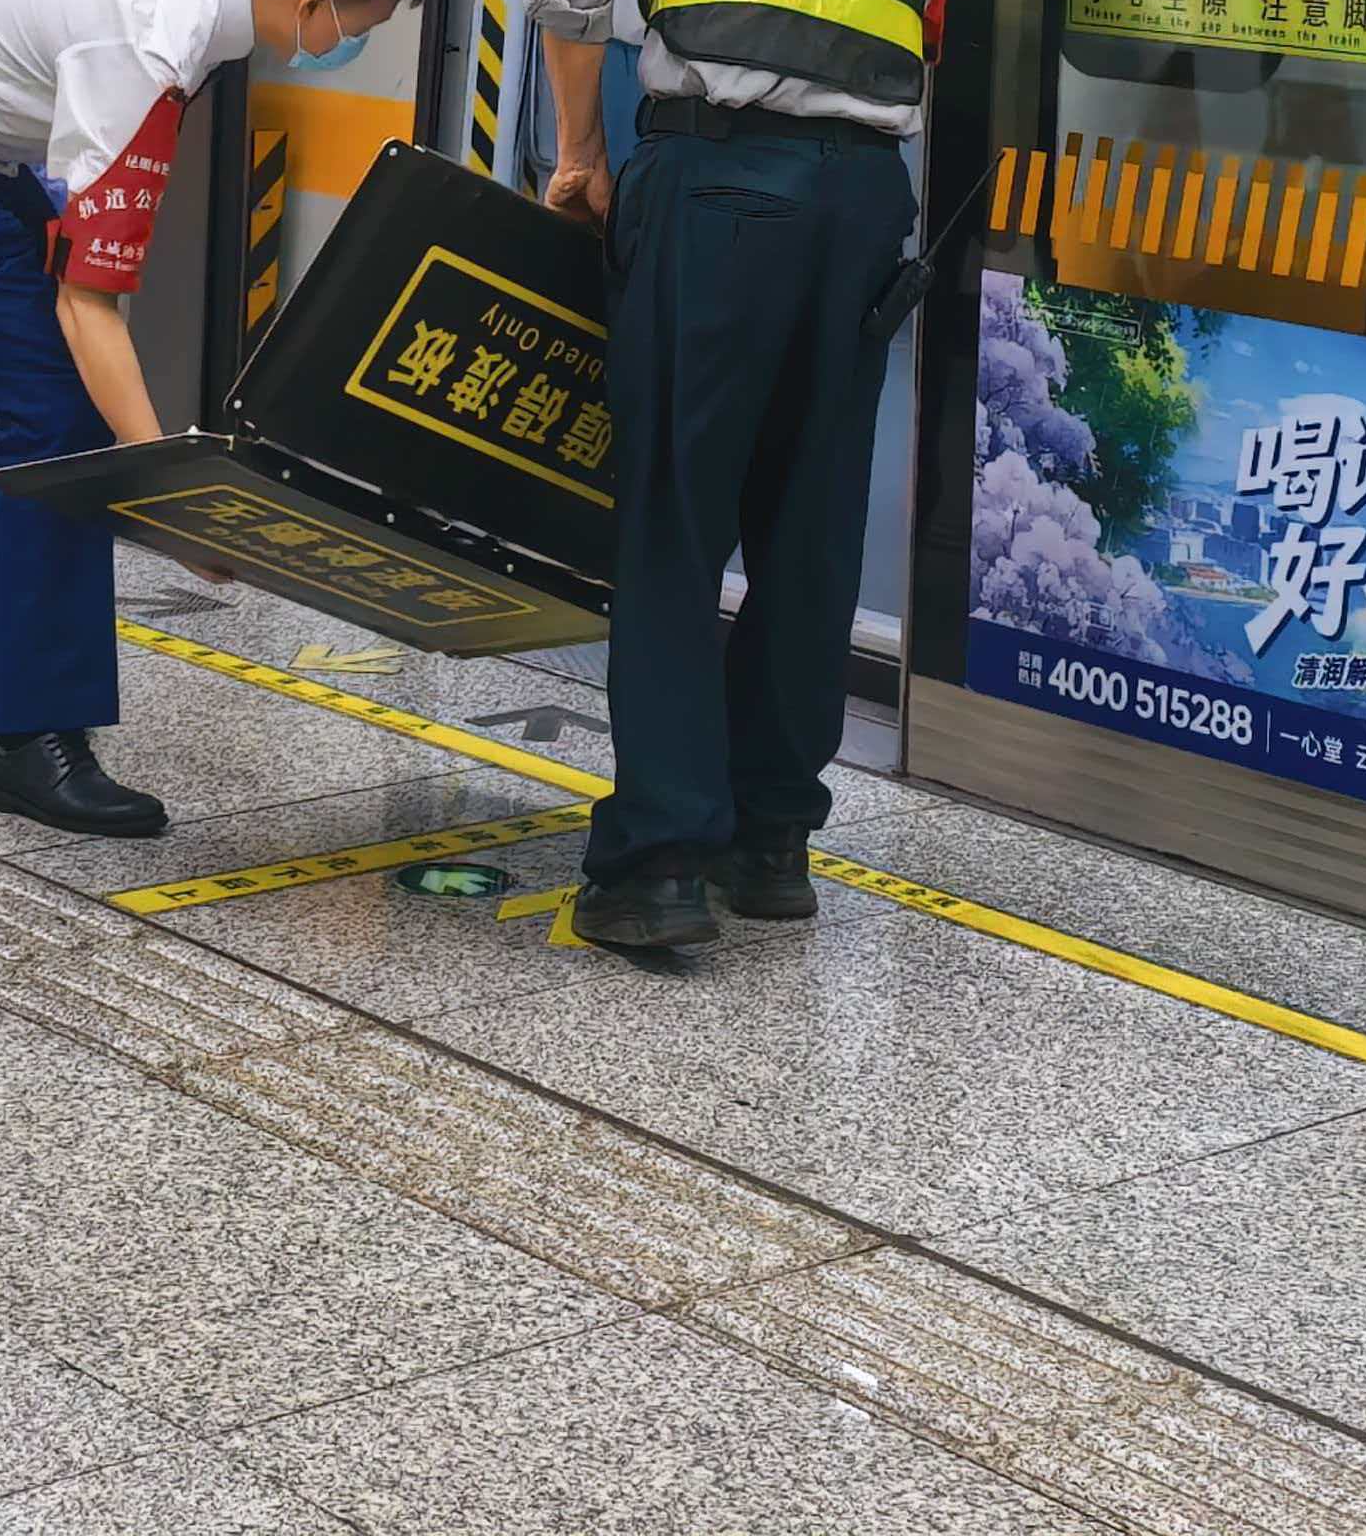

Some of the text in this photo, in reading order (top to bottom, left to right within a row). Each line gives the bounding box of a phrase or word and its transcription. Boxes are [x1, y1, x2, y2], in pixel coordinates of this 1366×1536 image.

[1083, 5, 1121, 23] Please
[1131, 12, 1161, 26] mind
[1170, 15, 1191, 30] the
[1201, 20, 1222, 36] gap
[1232, 22, 1286, 39] between
[1296, 28, 1317, 43] the
[1328, 33, 1362, 48] train
[78, 187, 165, 221] 轨道公
[479, 302, 540, 351] Only
[1048, 657, 1254, 746] 4000 515288
[1278, 732, 1343, 765] 一心堂
